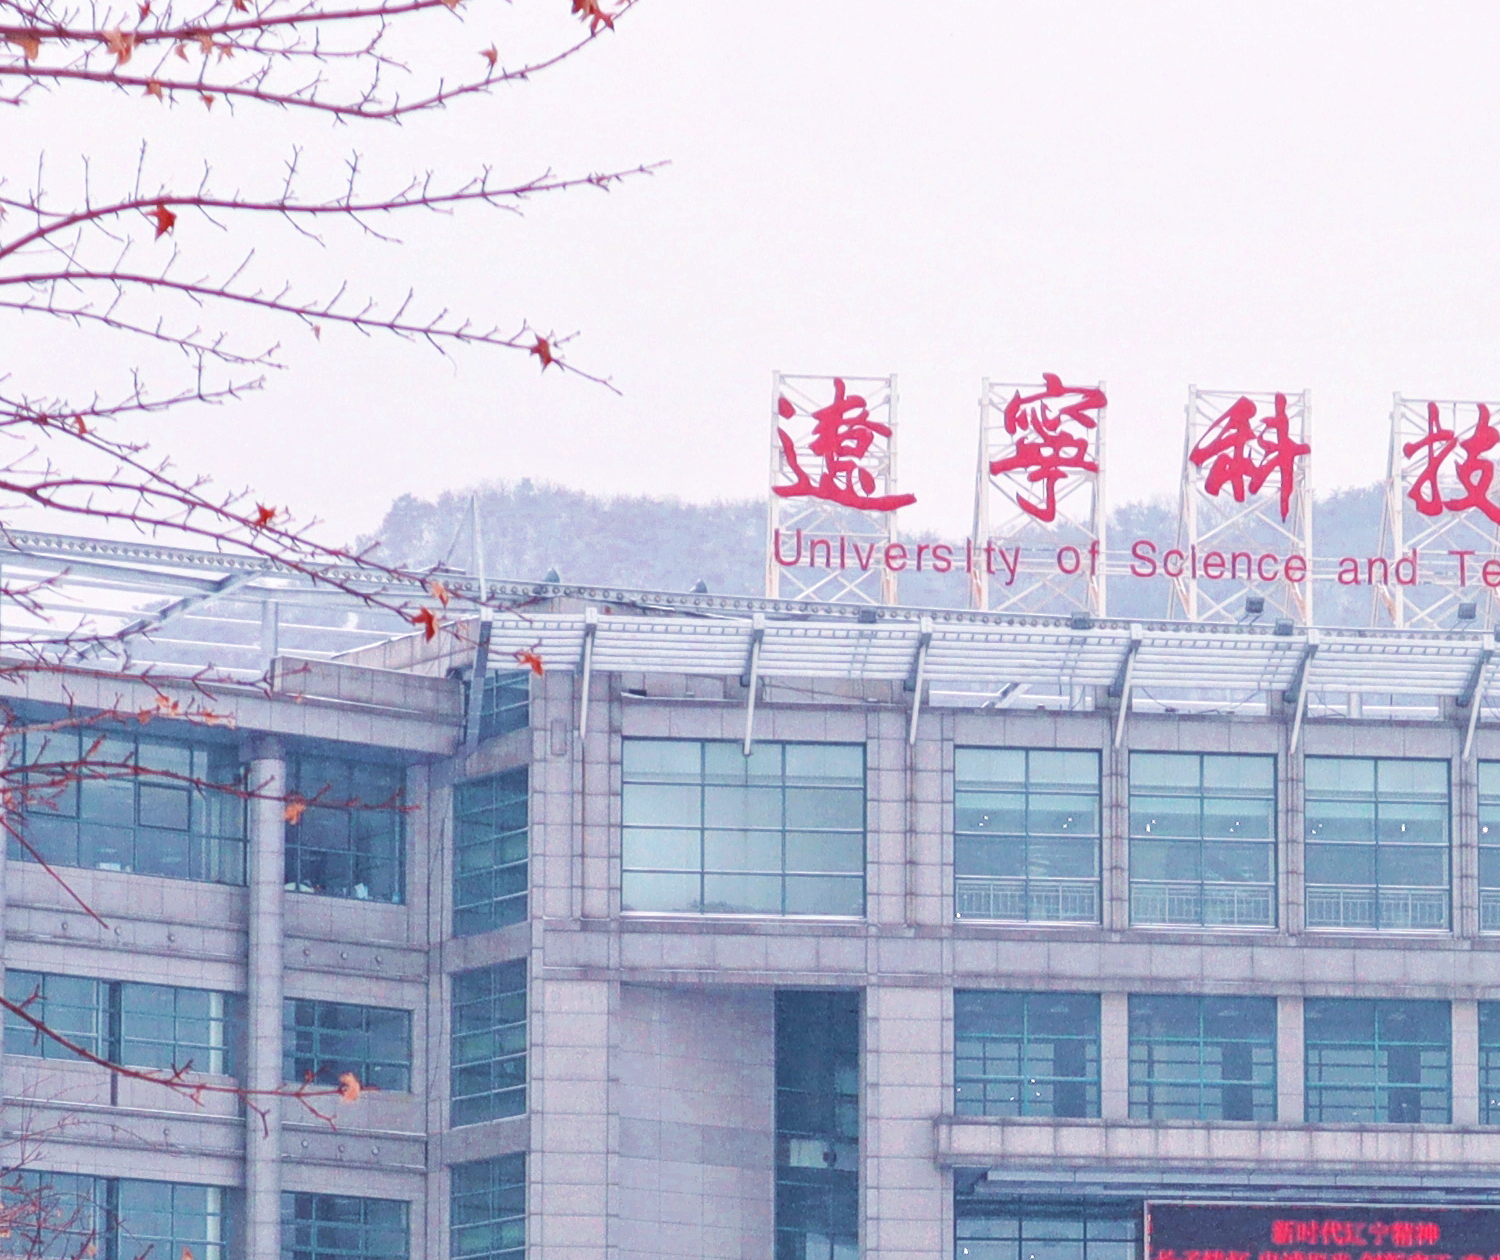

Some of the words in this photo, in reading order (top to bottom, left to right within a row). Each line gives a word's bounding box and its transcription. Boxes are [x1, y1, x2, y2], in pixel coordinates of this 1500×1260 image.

[772, 527, 1021, 586] University
[1056, 539, 1101, 576] of
[1129, 539, 1308, 583] Science
[1337, 547, 1418, 586] and
[1271, 1220, 1441, 1247] 新时代辽宁精神
